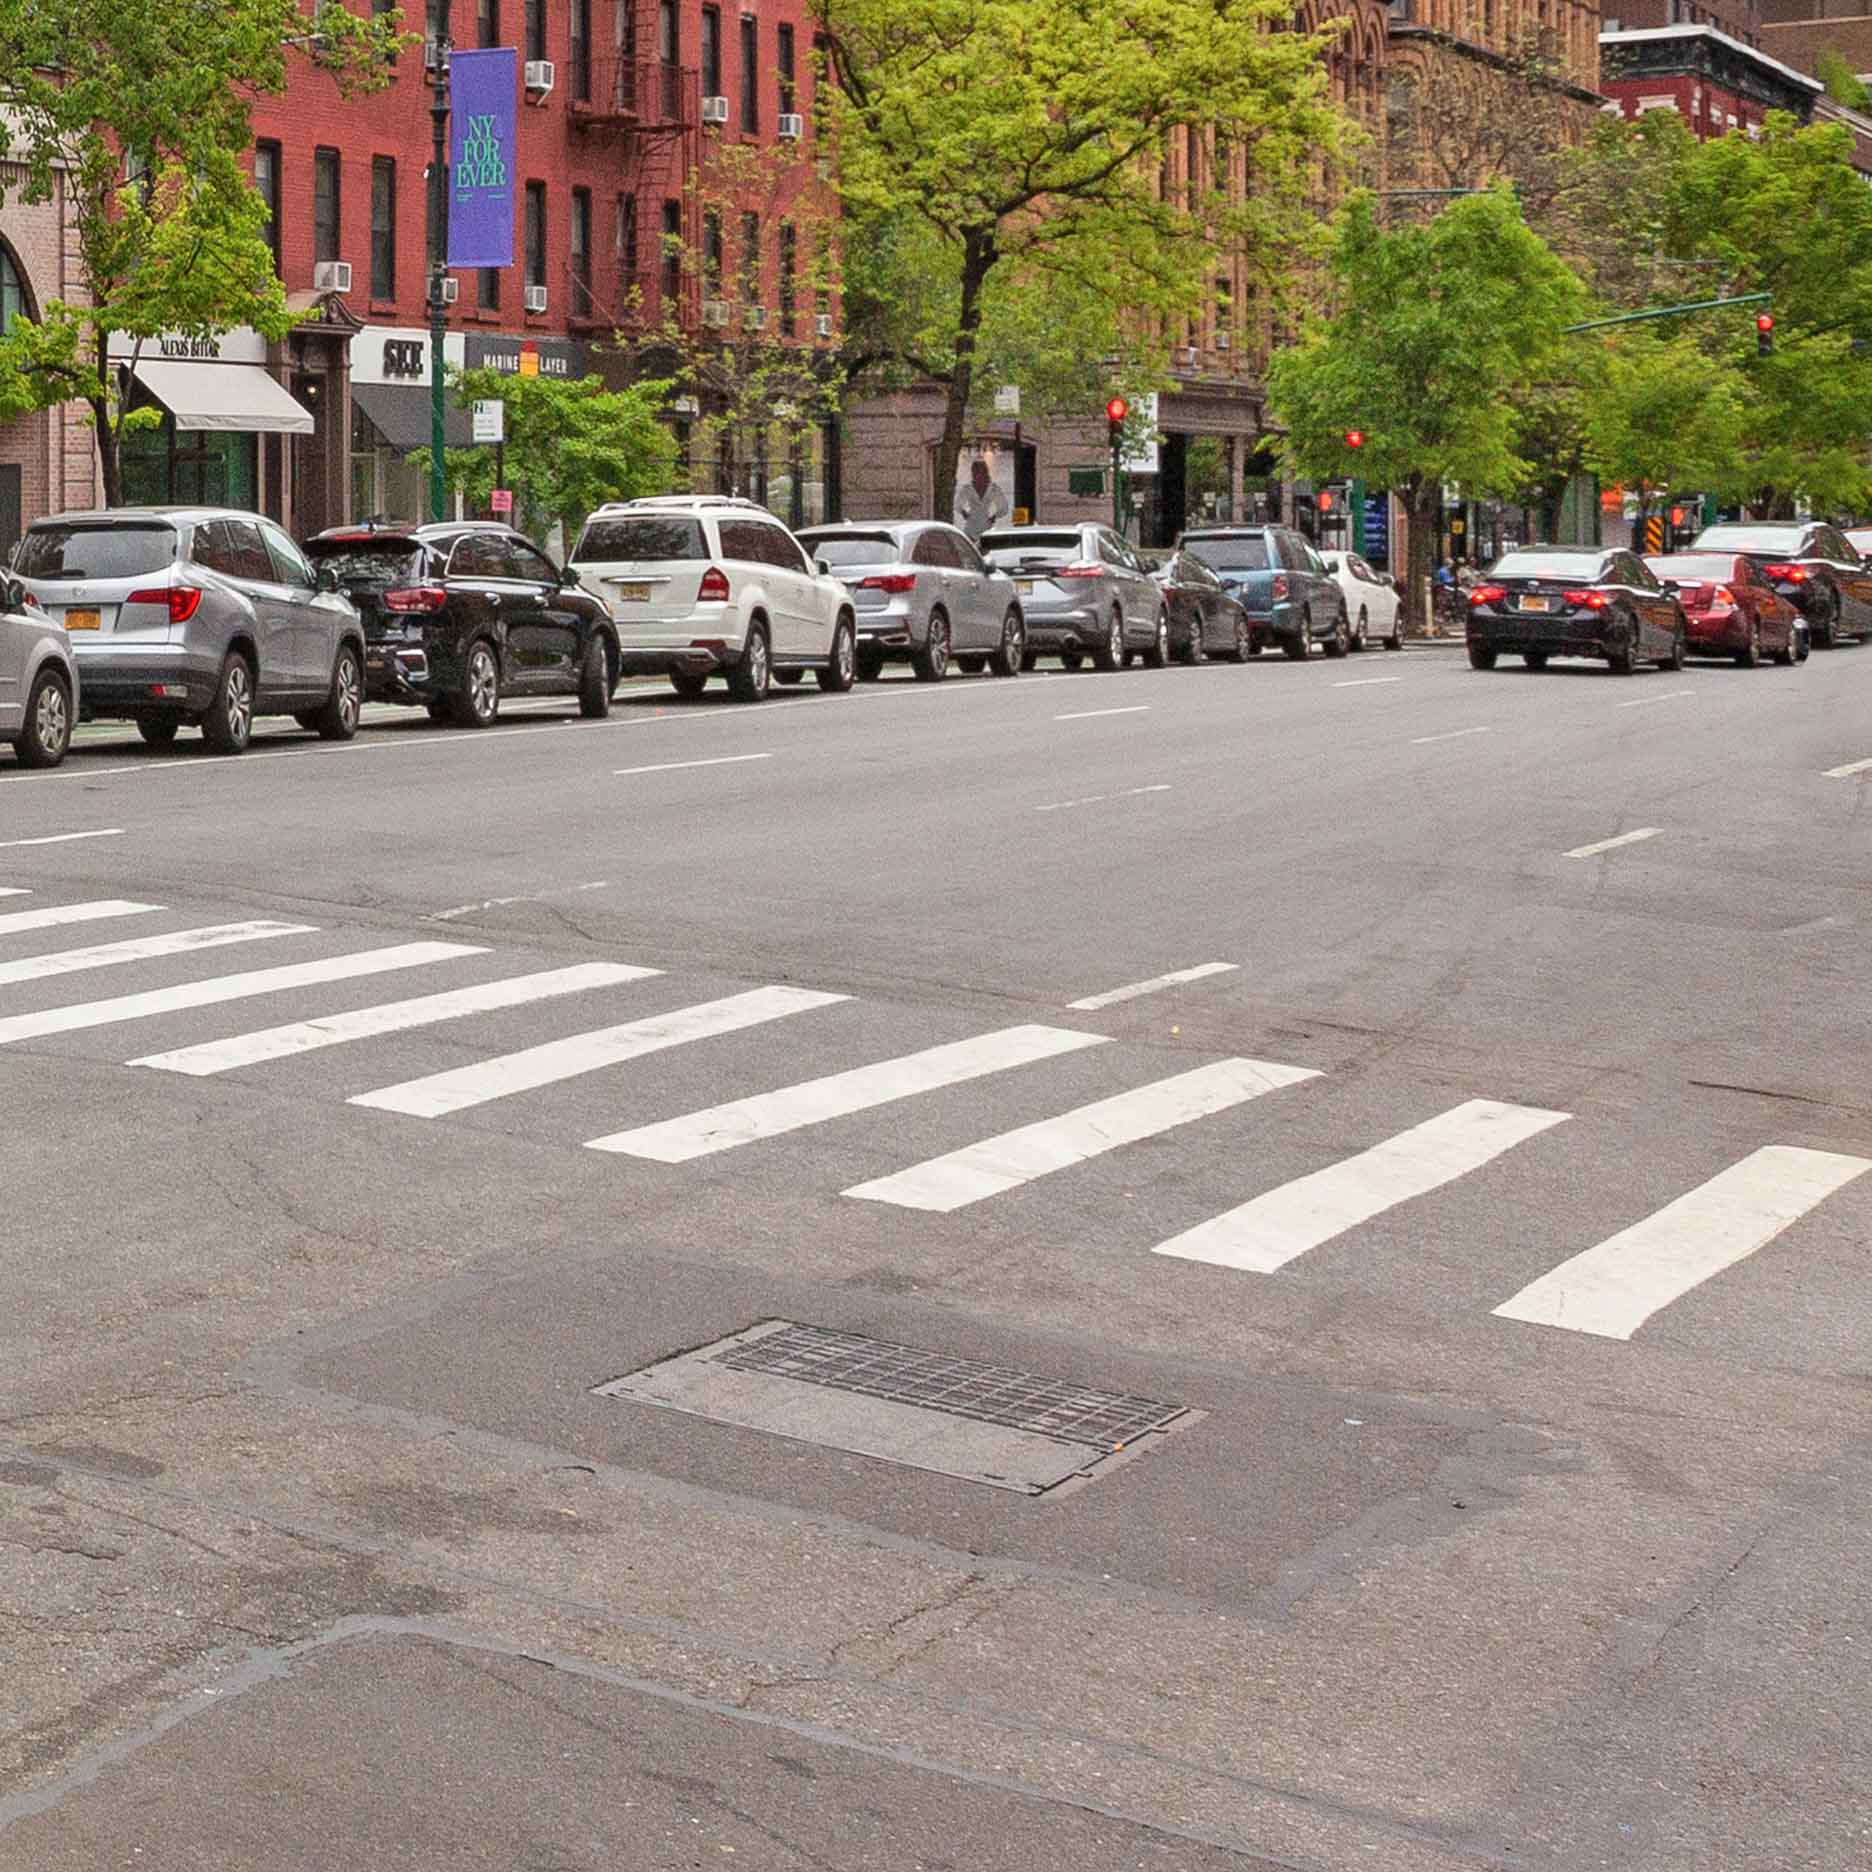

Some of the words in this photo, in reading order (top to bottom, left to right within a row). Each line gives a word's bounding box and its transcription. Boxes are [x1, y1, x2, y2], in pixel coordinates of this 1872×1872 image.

[467, 114, 496, 138] NY
[464, 137, 501, 162] FOR
[456, 161, 506, 187] EVER
[483, 354, 518, 371] MARINE
[540, 357, 567, 374] LAYER
